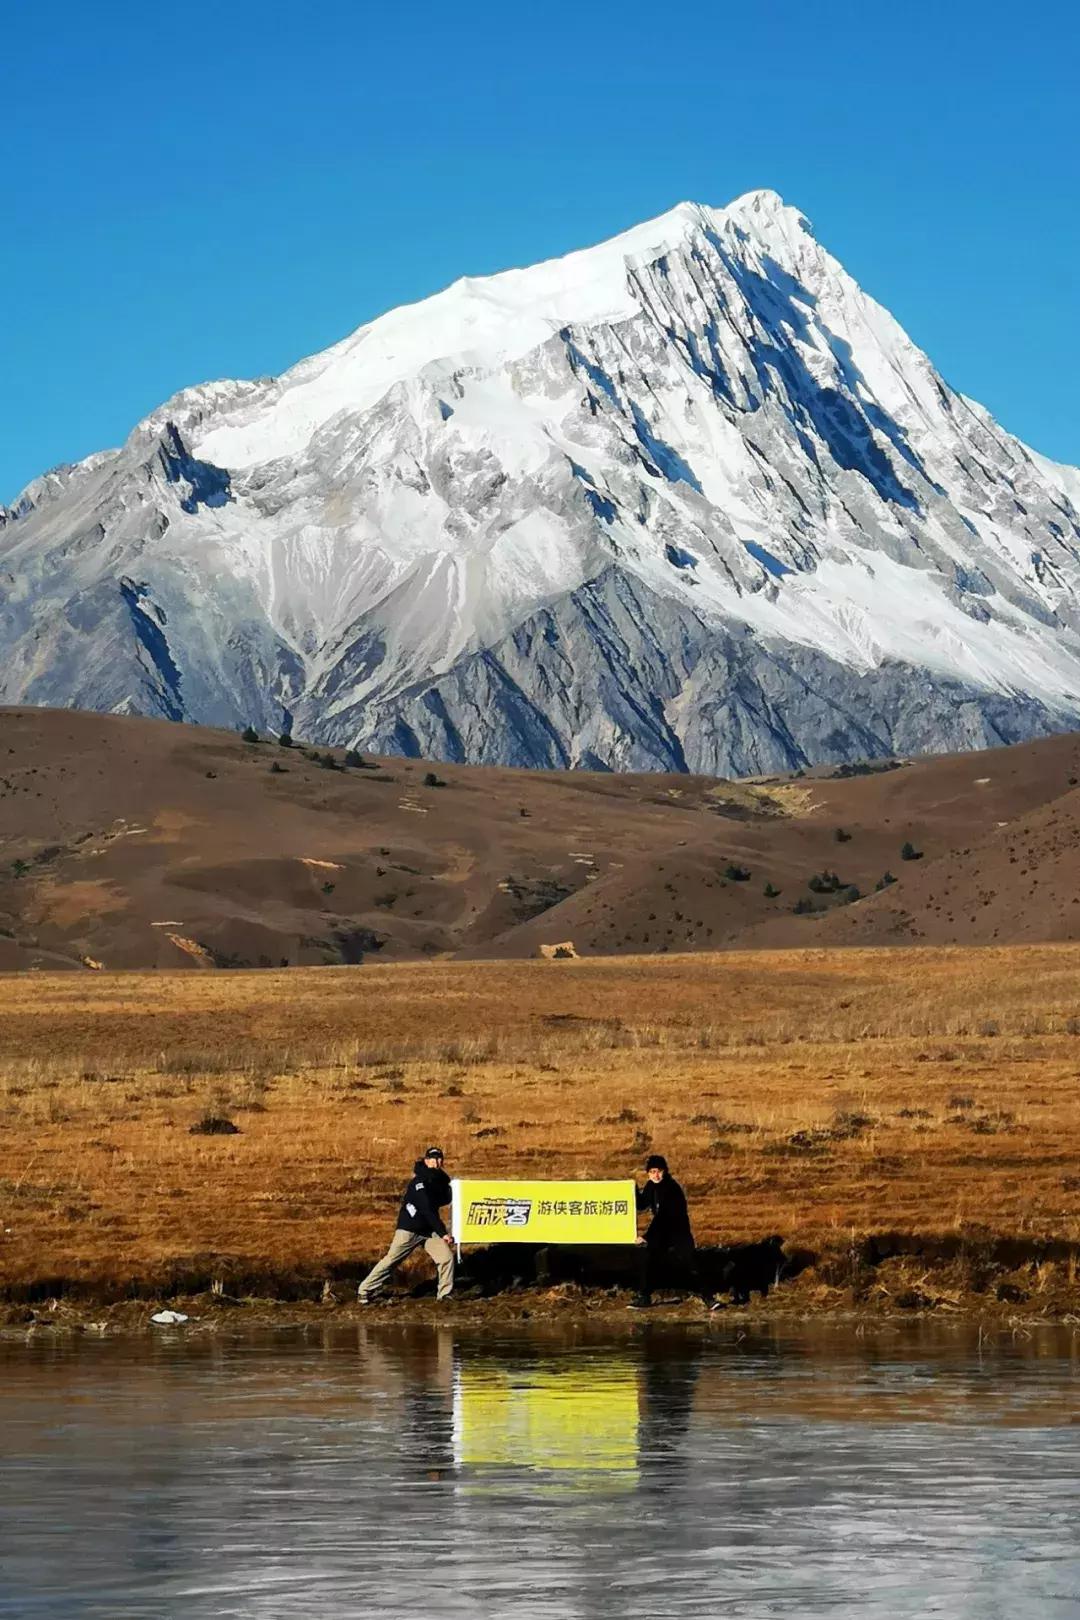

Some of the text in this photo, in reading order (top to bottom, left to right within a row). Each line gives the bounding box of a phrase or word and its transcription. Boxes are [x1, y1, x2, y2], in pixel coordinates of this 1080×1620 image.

[537, 1200, 628, 1216] 游侠客旅游网
